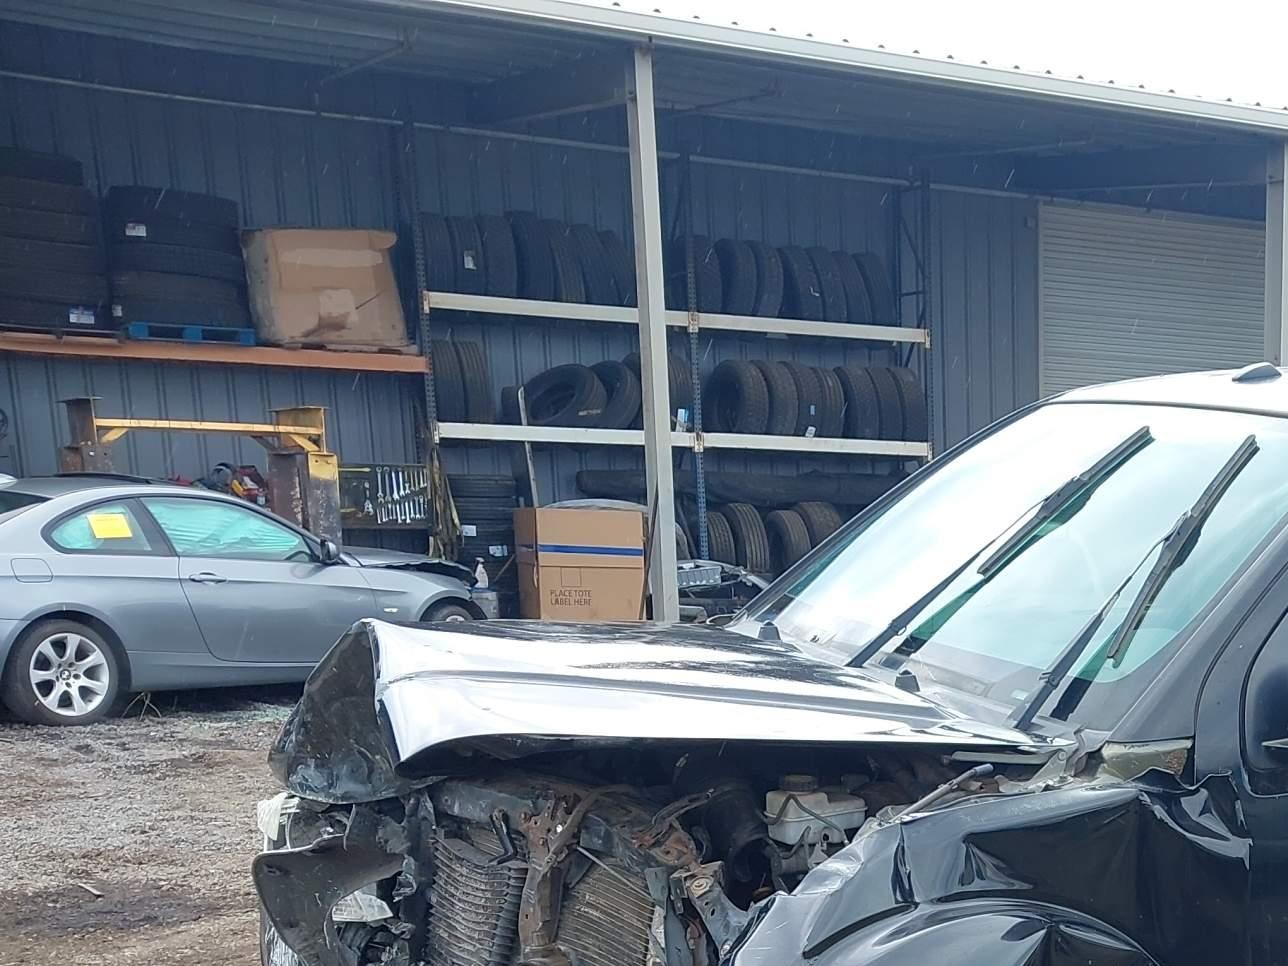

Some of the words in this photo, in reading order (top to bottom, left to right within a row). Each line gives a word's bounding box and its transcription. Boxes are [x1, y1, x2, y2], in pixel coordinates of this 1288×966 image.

[550, 589, 572, 598] PLACE
[573, 589, 592, 598] TOTE
[550, 597, 571, 606] LABEL
[573, 598, 592, 606] HERE
